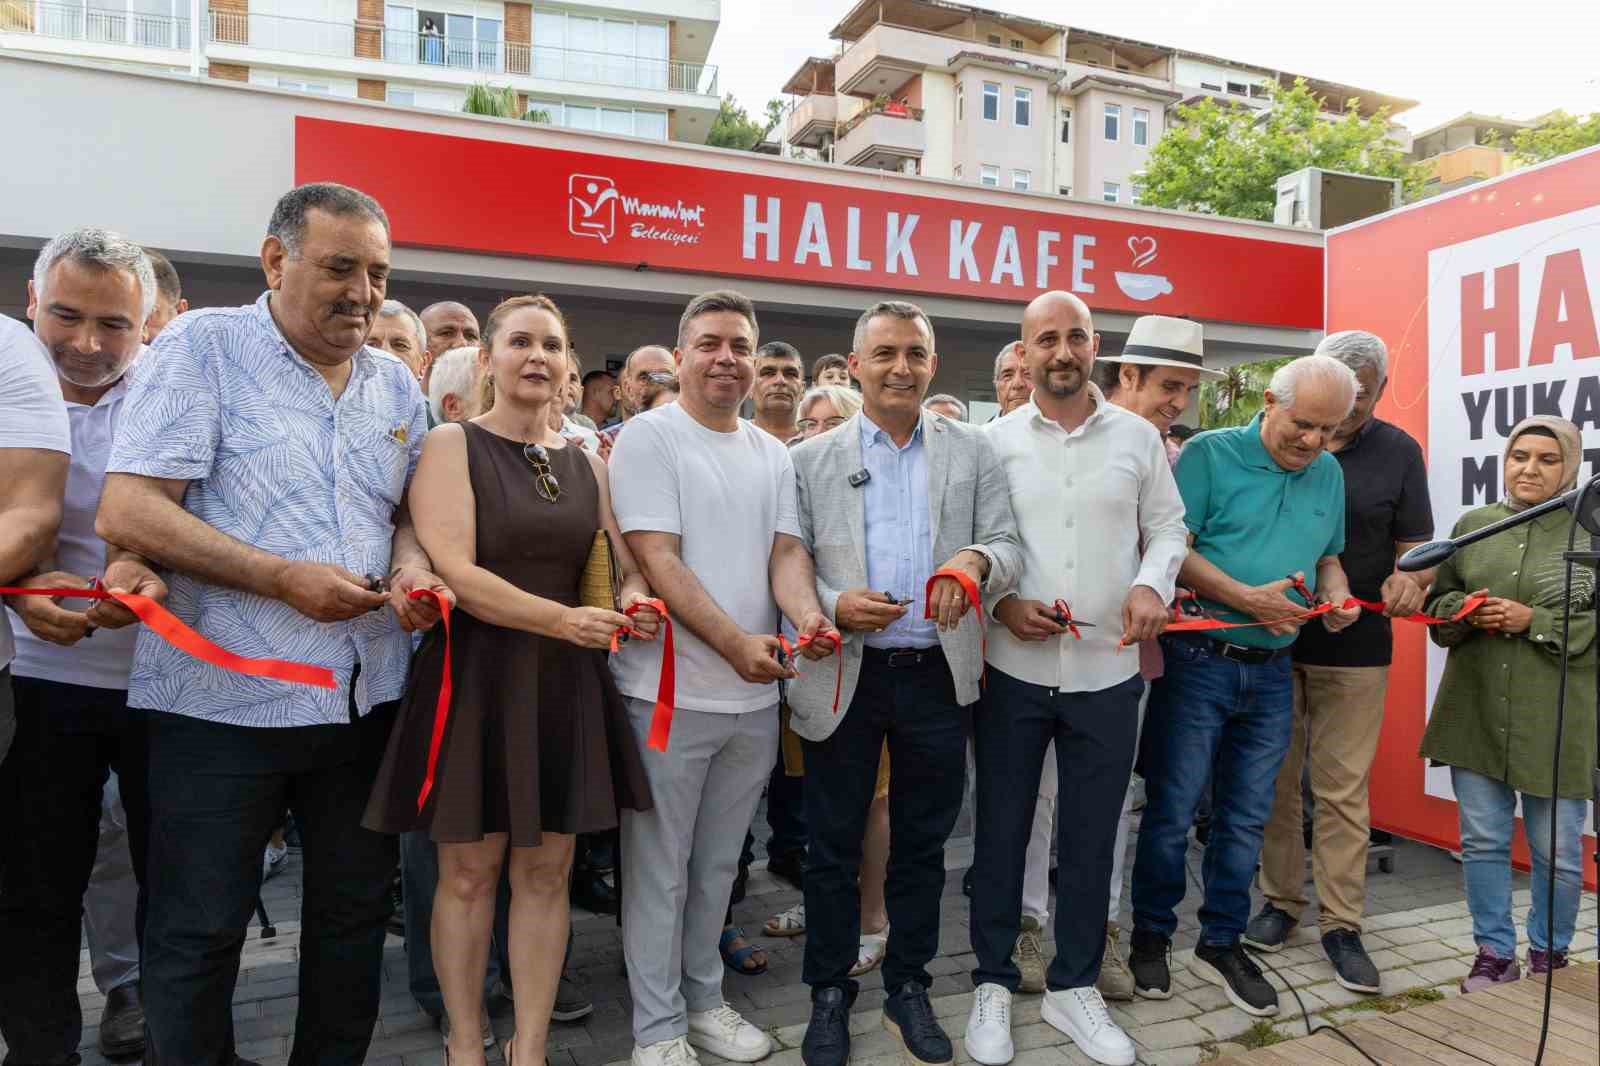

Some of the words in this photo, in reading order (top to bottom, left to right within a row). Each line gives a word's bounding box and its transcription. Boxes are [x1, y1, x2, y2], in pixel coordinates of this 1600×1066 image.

[629, 222, 700, 246] Belediyesi
[742, 193, 920, 276] HALK
[947, 218, 1097, 293] KAFE
